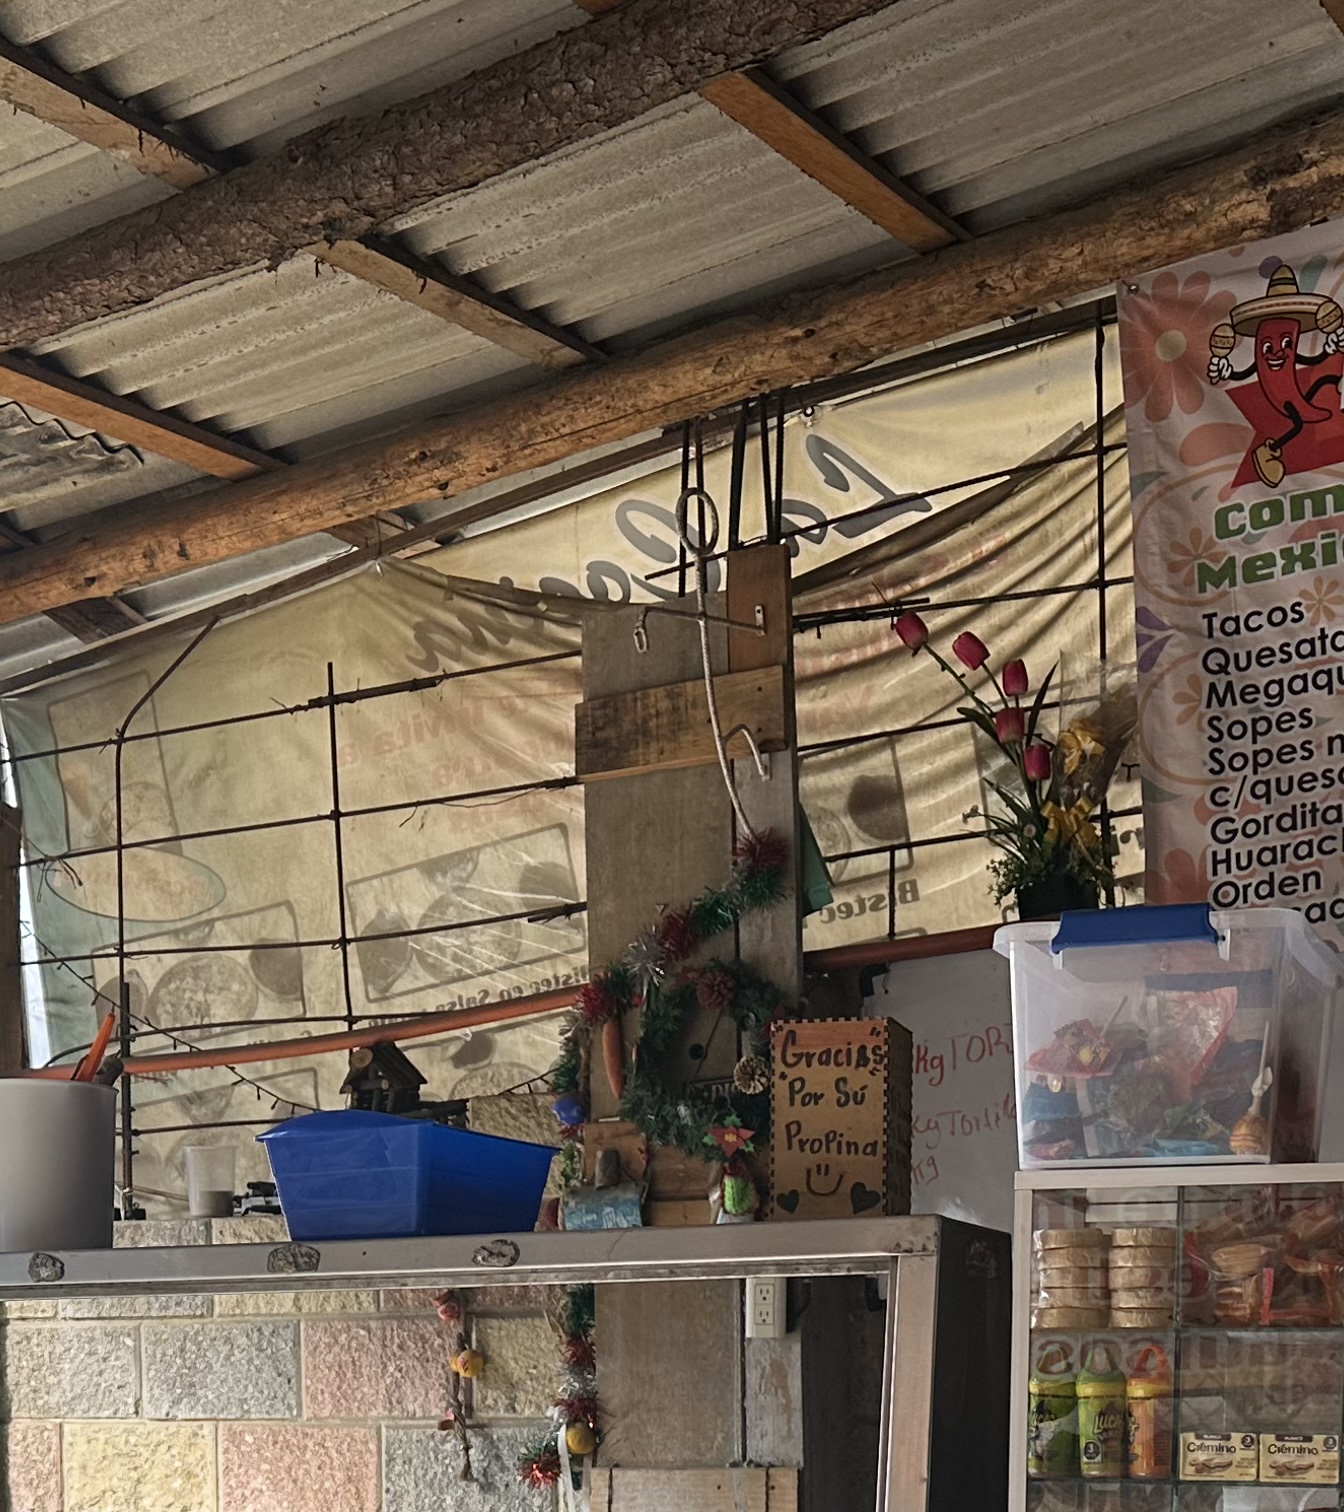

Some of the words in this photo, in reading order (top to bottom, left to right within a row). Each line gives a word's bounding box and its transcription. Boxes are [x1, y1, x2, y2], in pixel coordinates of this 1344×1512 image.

[1202, 601, 1306, 640] Tacos
[1207, 706, 1314, 748] Sopes
[1208, 741, 1315, 781] Sopes
[1211, 870, 1323, 909] Orden
